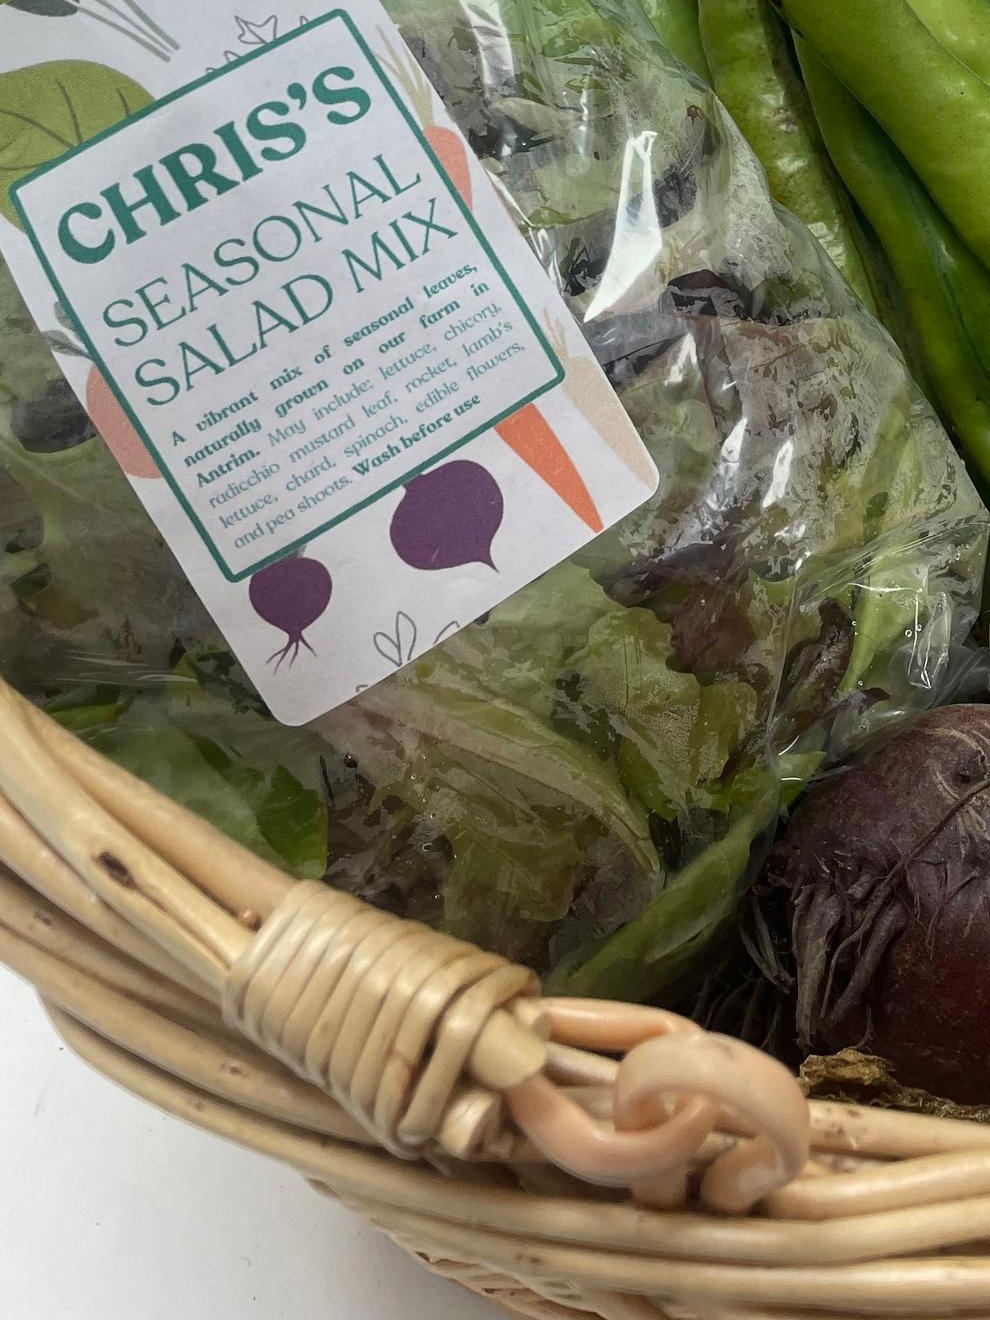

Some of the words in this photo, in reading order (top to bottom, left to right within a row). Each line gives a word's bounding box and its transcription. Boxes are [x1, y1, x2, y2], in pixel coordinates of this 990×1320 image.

[56, 65, 372, 265] CHRIS'S
[102, 153, 422, 347] SEASONAL
[133, 273, 334, 406] SALAD
[340, 196, 459, 293] MIX
[171, 430, 186, 447] A
[195, 391, 259, 432] vibrant
[269, 366, 303, 390] mix
[313, 344, 332, 364] of
[343, 295, 415, 347] seasonal
[422, 264, 478, 299] leaves,
[183, 418, 262, 468] naturally
[274, 379, 330, 418] grown
[342, 358, 365, 375] on
[378, 331, 406, 354] our
[418, 300, 461, 329] farm
[469, 282, 490, 297] in
[196, 449, 261, 488] Antrim.
[267, 419, 306, 447] May
[311, 379, 373, 420] include:
[378, 343, 437, 380] lettuce,
[443, 303, 501, 341] chicory,
[208, 463, 280, 509] radicchio
[288, 414, 356, 463] mustard
[361, 390, 398, 418] leaf,
[405, 358, 457, 393] rocket,
[462, 321, 513, 357] lamb's
[218, 494, 278, 529] lettuce,
[285, 455, 336, 491] chard,
[343, 415, 408, 458] spinach,
[415, 381, 459, 413] edible
[466, 342, 525, 381] flowers,
[233, 522, 265, 549] and
[265, 508, 295, 535] pea
[297, 476, 353, 512] shoots.
[350, 443, 402, 476] Wash
[398, 412, 453, 449] before
[453, 394, 481, 416] use
